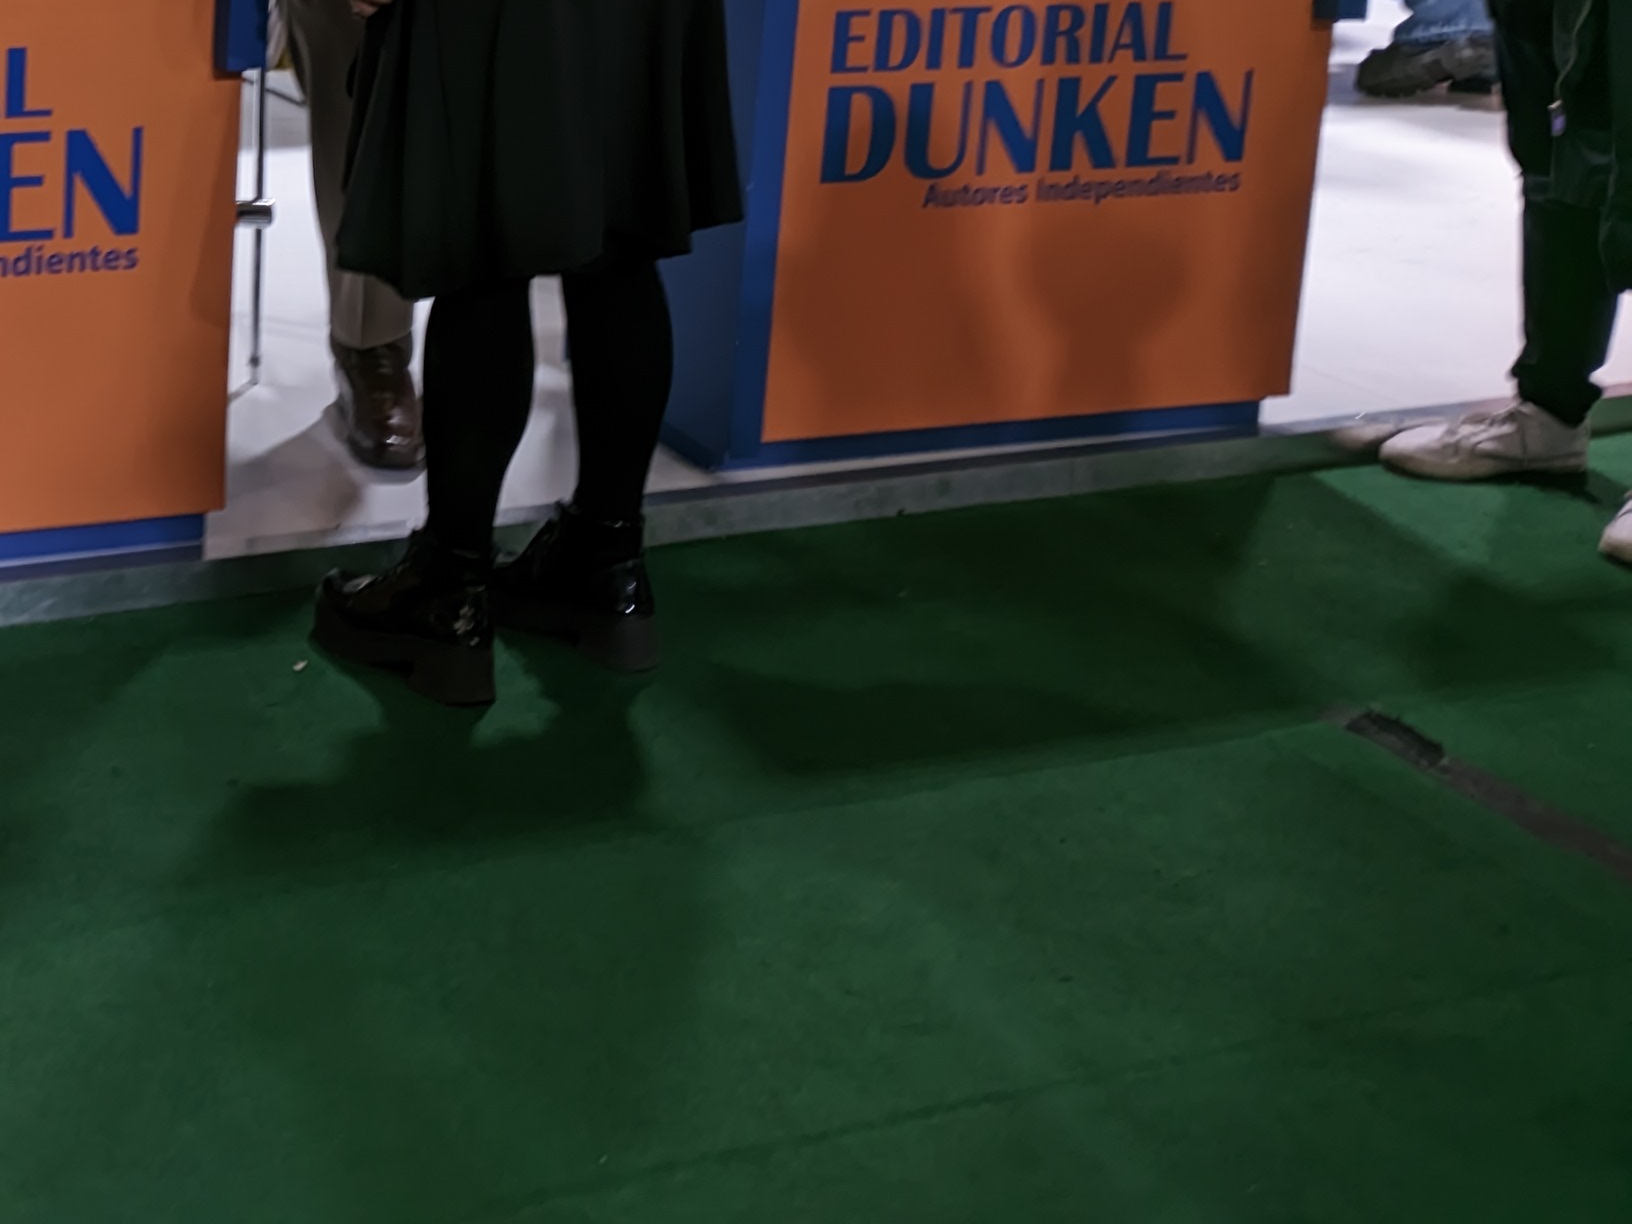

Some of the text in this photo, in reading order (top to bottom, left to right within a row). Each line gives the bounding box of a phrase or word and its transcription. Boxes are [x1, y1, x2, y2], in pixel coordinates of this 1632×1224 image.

[830, 0, 1189, 75] EDITORIAL
[819, 68, 1255, 185] DUNKEN
[921, 169, 1241, 210] Autores Independientes
